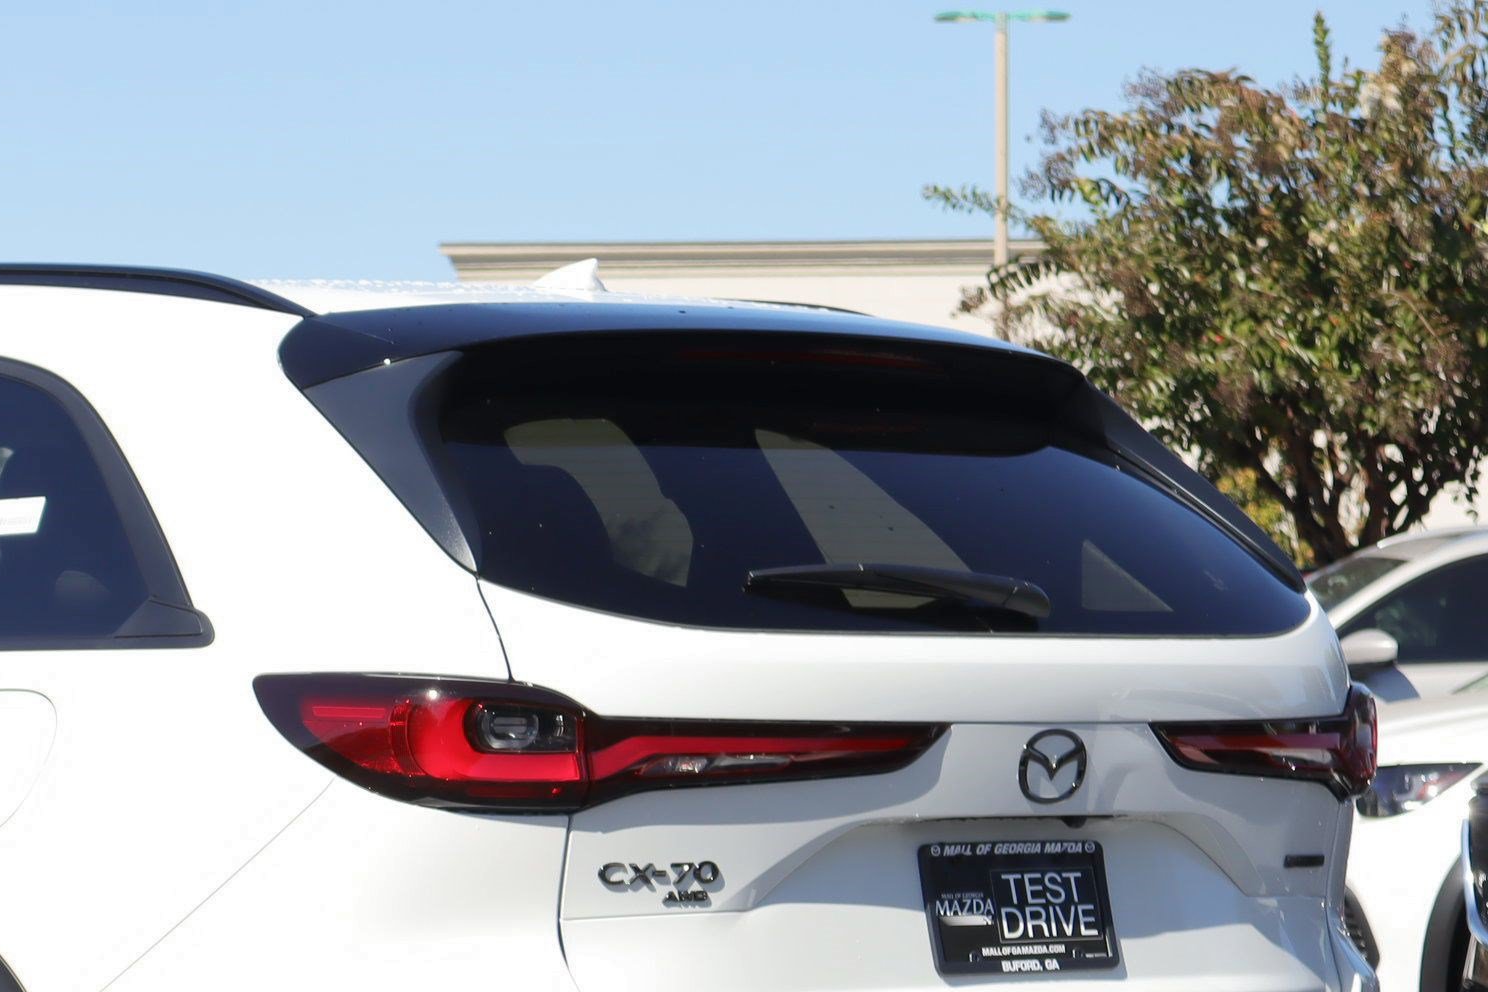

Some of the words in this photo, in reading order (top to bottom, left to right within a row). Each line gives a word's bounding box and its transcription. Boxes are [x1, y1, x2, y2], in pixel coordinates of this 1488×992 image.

[943, 845, 971, 856] MALL
[976, 844, 991, 855] OF
[994, 843, 1041, 854] GEORGIA
[597, 860, 721, 887] CX-70
[1001, 872, 1081, 904] TEST
[936, 899, 994, 916] MAZDA
[1001, 905, 1098, 939] DRIVE
[982, 945, 1065, 956] MALLOFGAMAZDA.COM
[1001, 959, 1044, 973] BUFORD,
[1045, 958, 1061, 971] GA
